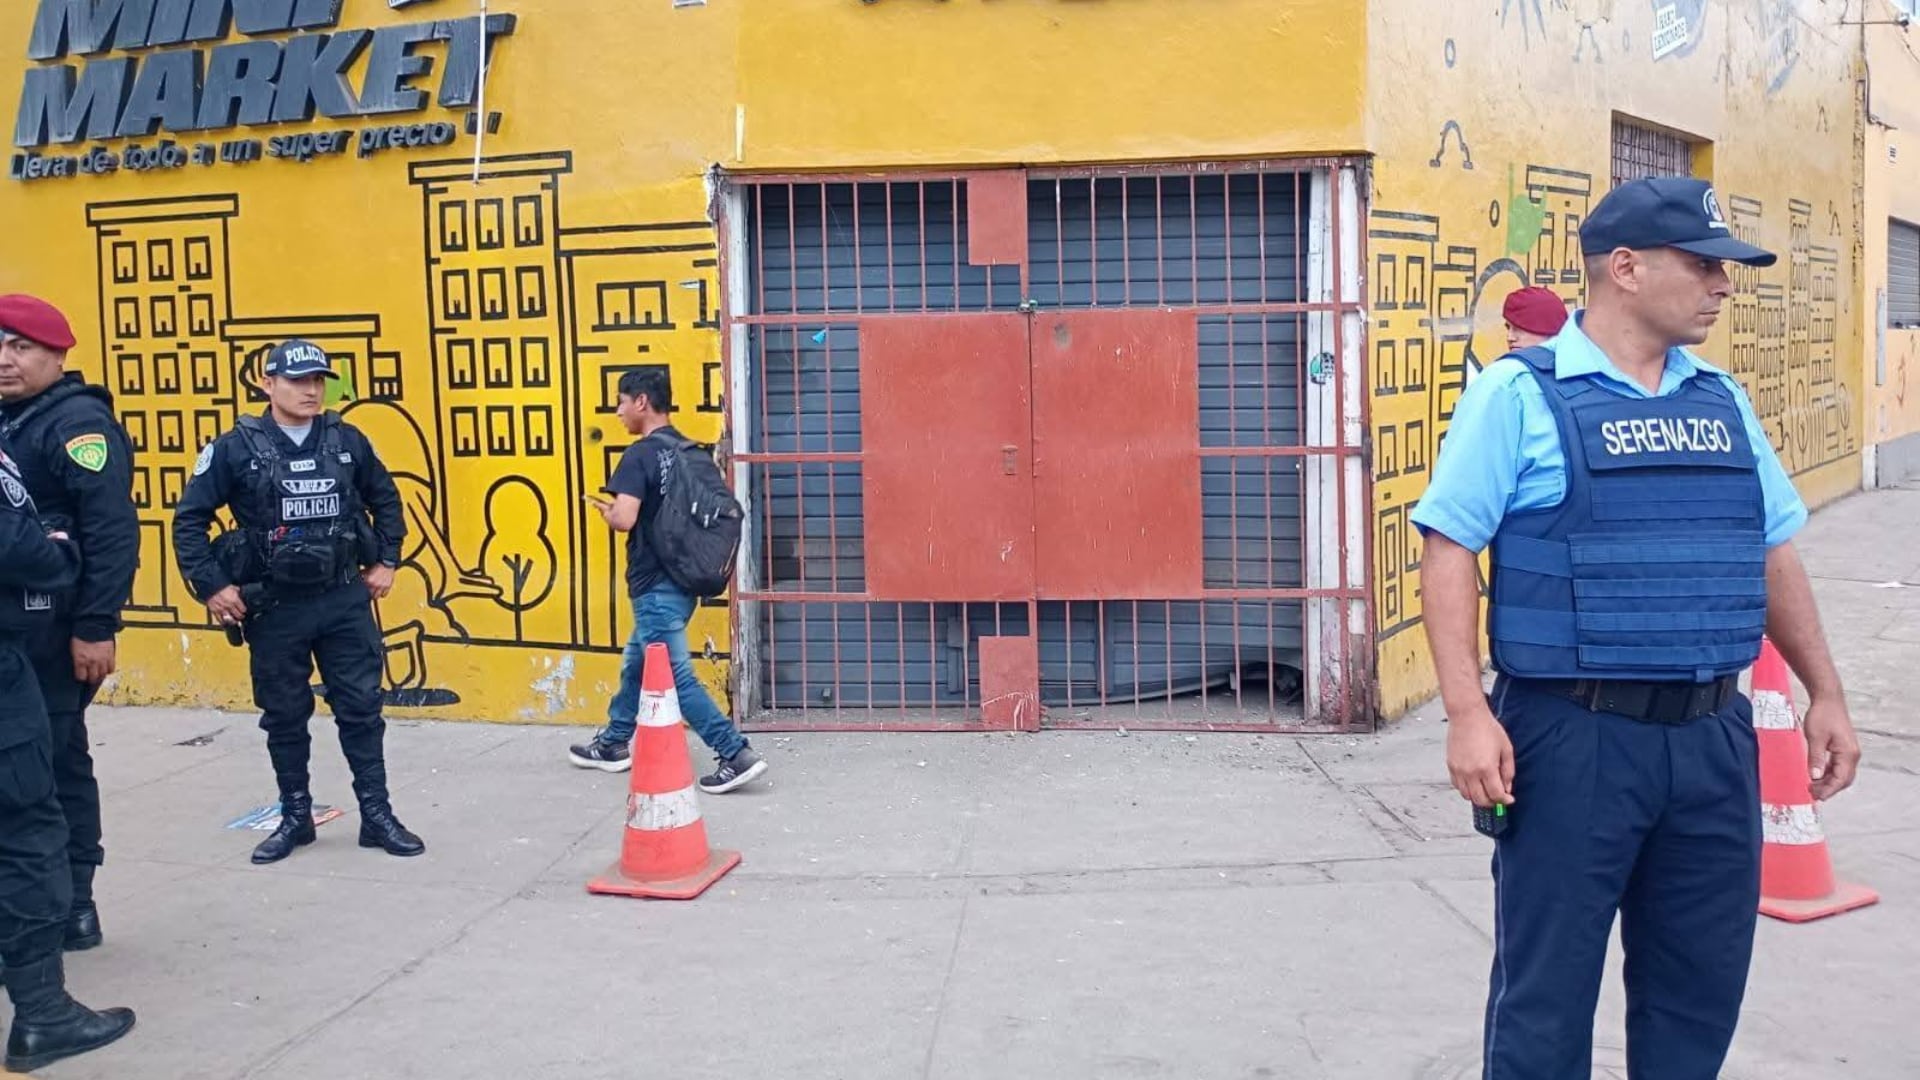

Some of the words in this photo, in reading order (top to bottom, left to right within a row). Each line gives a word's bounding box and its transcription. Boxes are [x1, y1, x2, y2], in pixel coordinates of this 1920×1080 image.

[14, 13, 517, 147] MARKET
[10, 153, 78, 181] Lleva
[80, 147, 119, 174] de
[122, 140, 188, 170] todo
[192, 143, 216, 165] a
[220, 139, 262, 163] un
[265, 130, 353, 162] super
[1601, 418, 1732, 455] SERENAZGO
[286, 498, 337, 517] POLICIA
